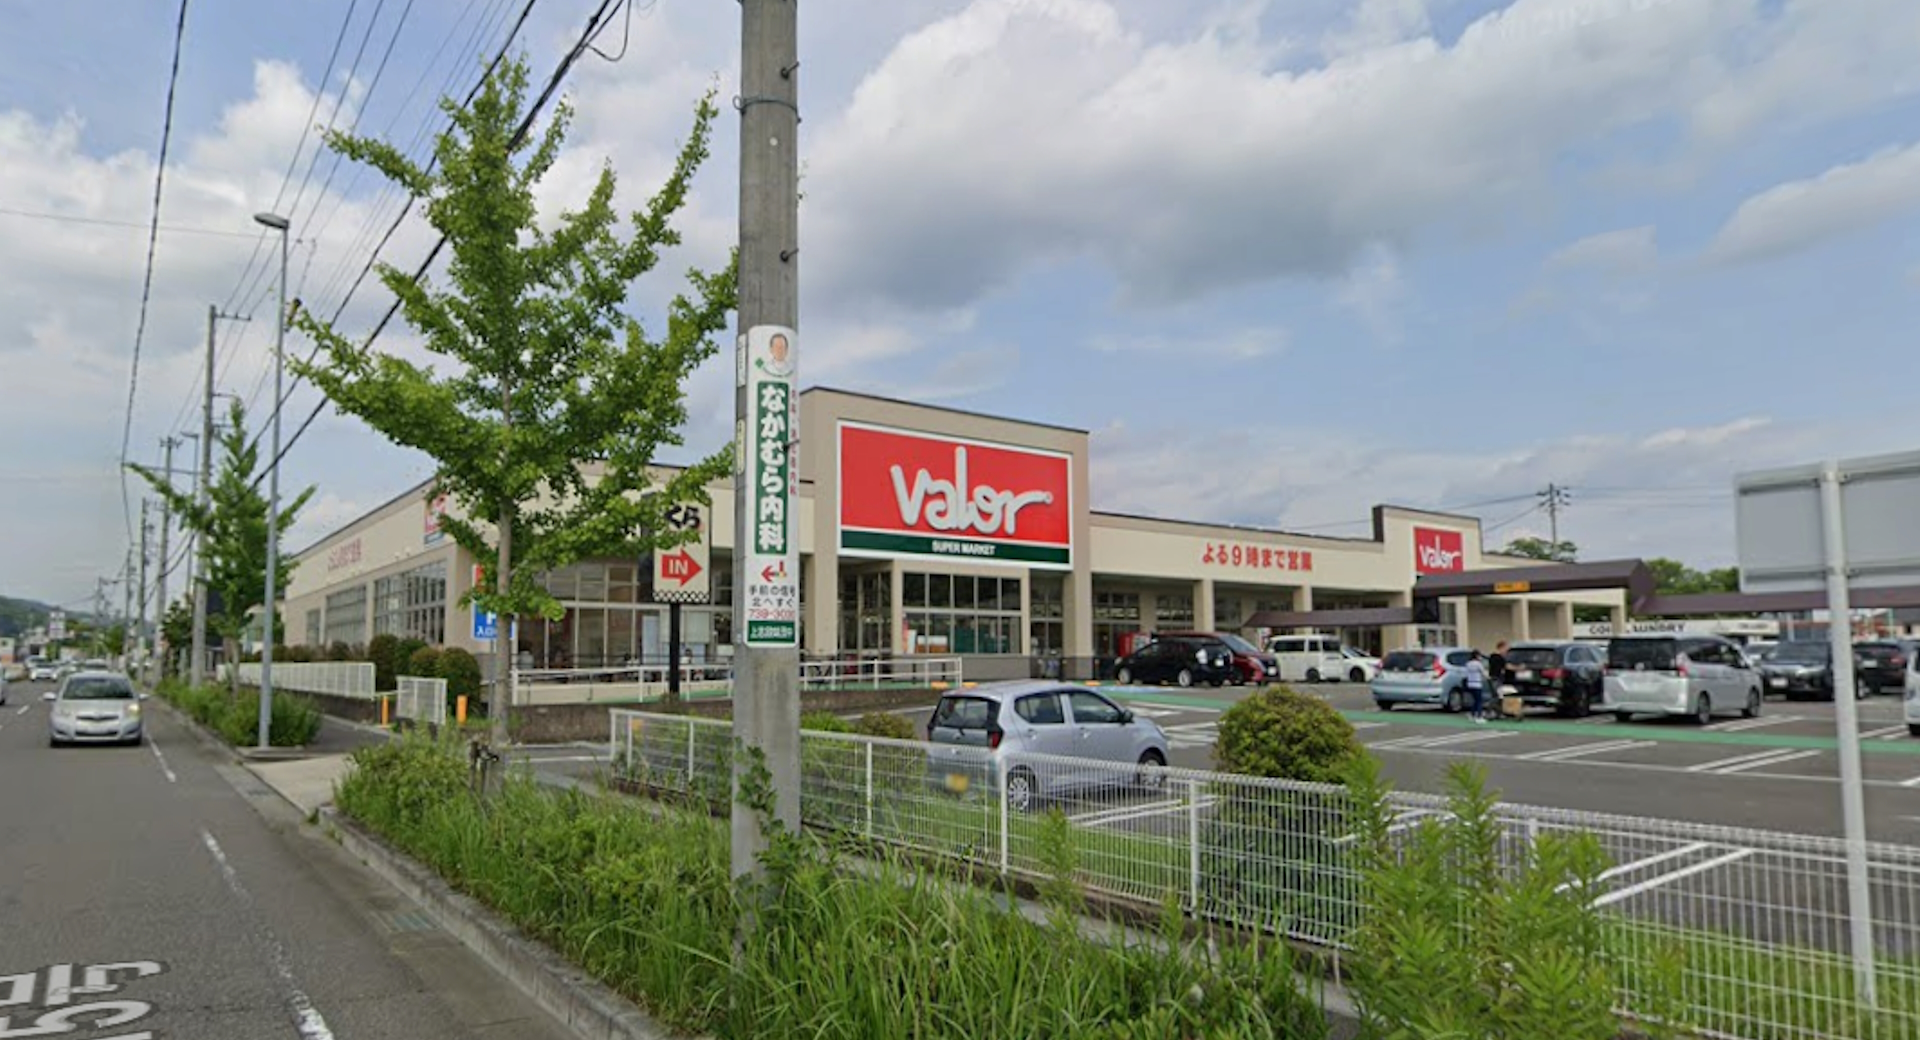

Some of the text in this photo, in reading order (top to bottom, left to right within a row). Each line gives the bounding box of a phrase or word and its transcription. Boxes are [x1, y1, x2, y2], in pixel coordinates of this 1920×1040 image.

[759, 385, 786, 552] なかむら内科
[665, 504, 701, 529] くら
[932, 540, 996, 556] SUPER MARKET
[1202, 543, 1312, 571] よる9時まで営業
[668, 559, 688, 575] IN
[752, 597, 794, 607] 北へすぐ
